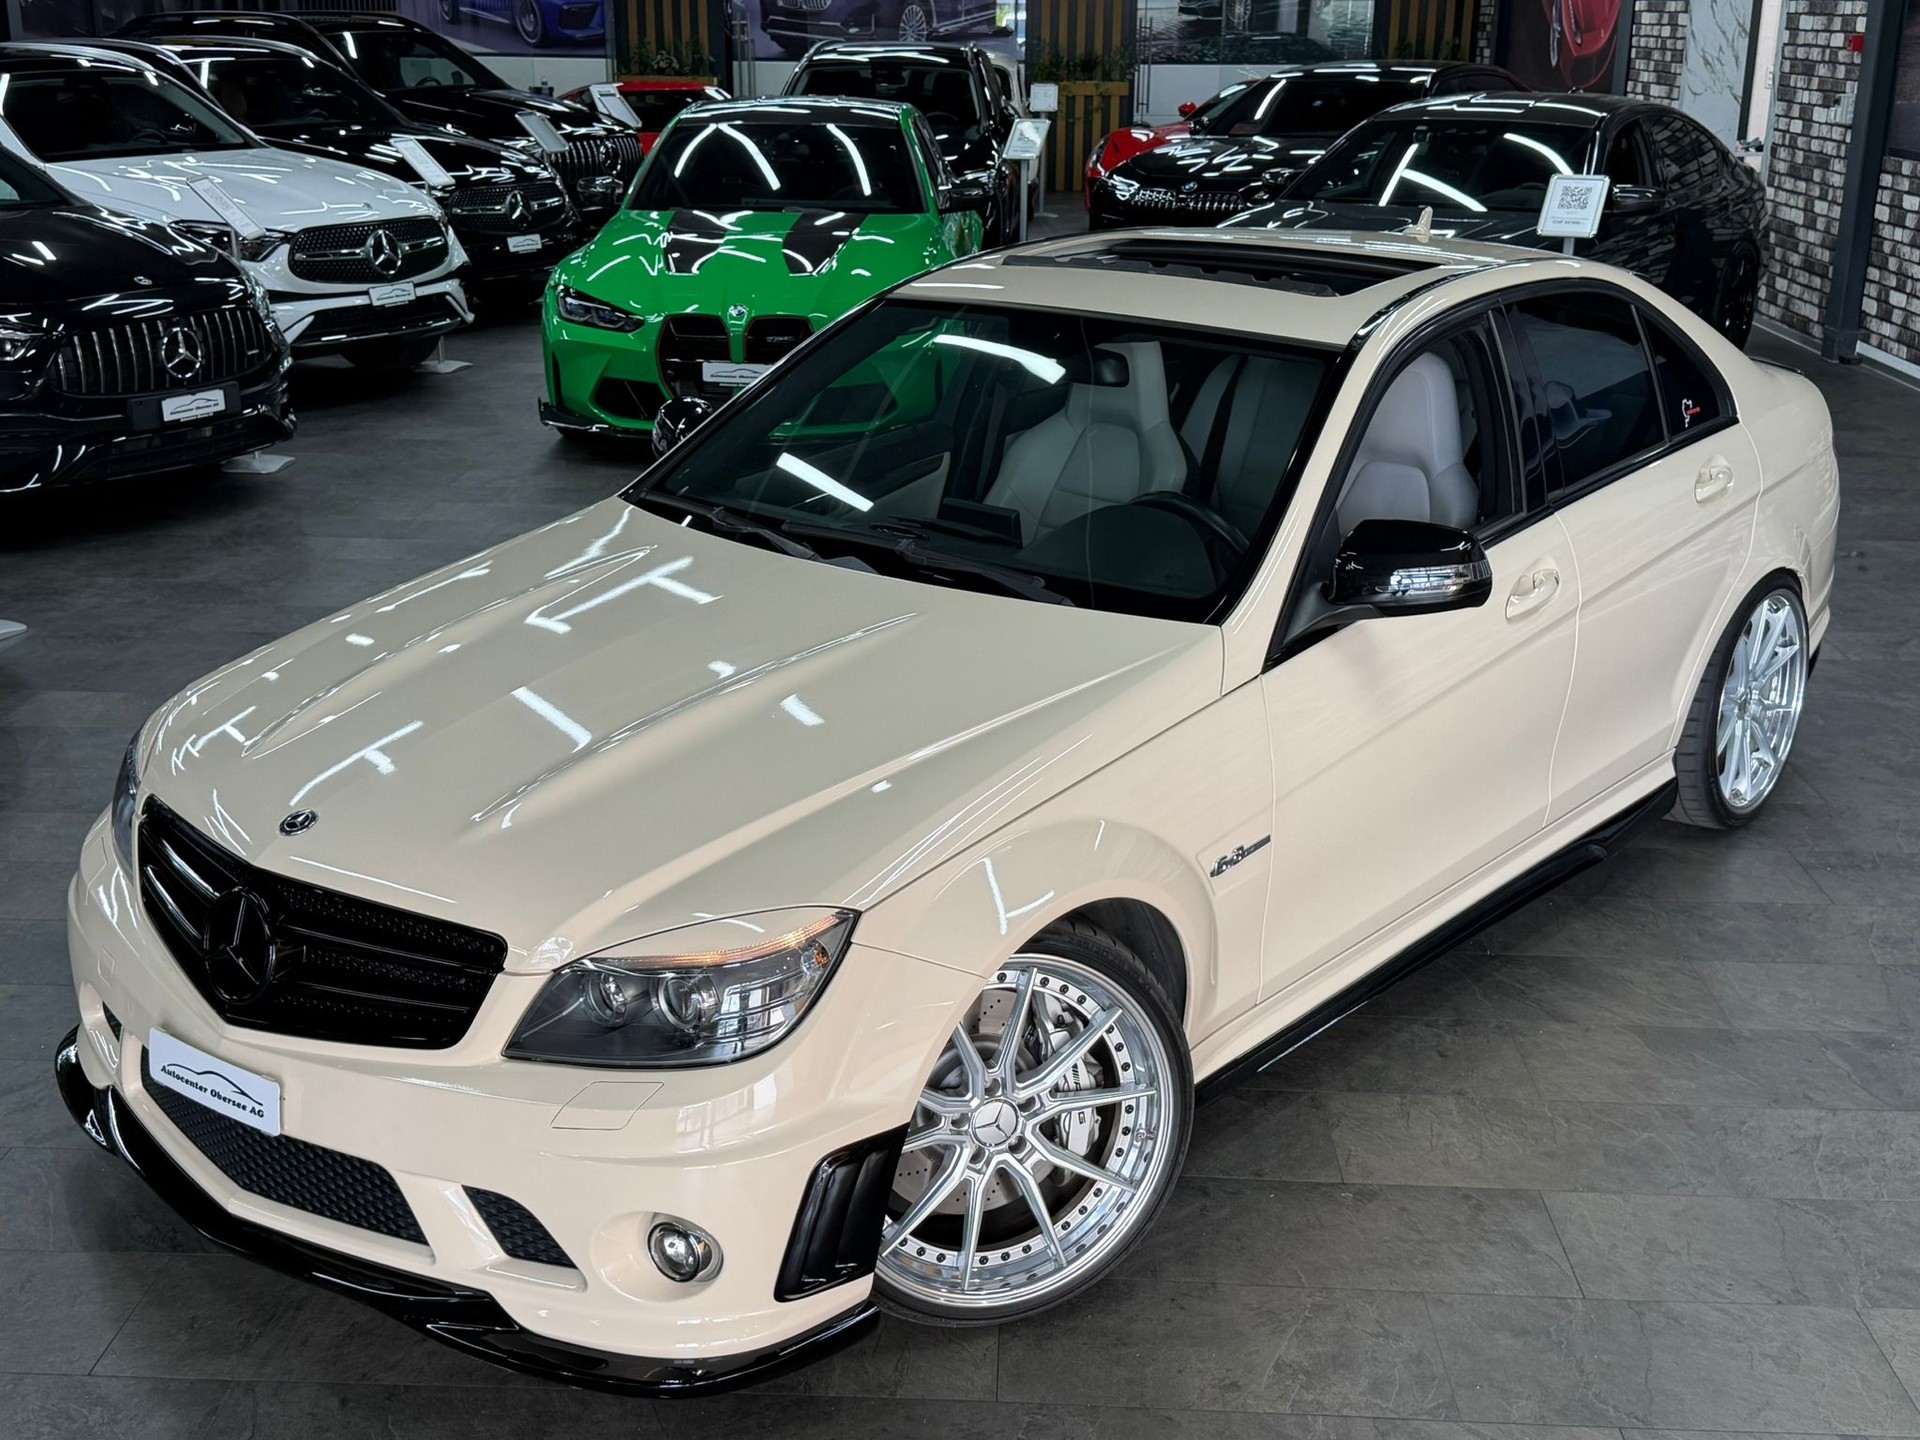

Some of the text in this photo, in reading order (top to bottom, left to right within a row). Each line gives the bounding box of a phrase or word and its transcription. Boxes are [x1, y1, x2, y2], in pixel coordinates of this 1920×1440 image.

[160, 1064, 265, 1118] Autocenter Obersee AG
